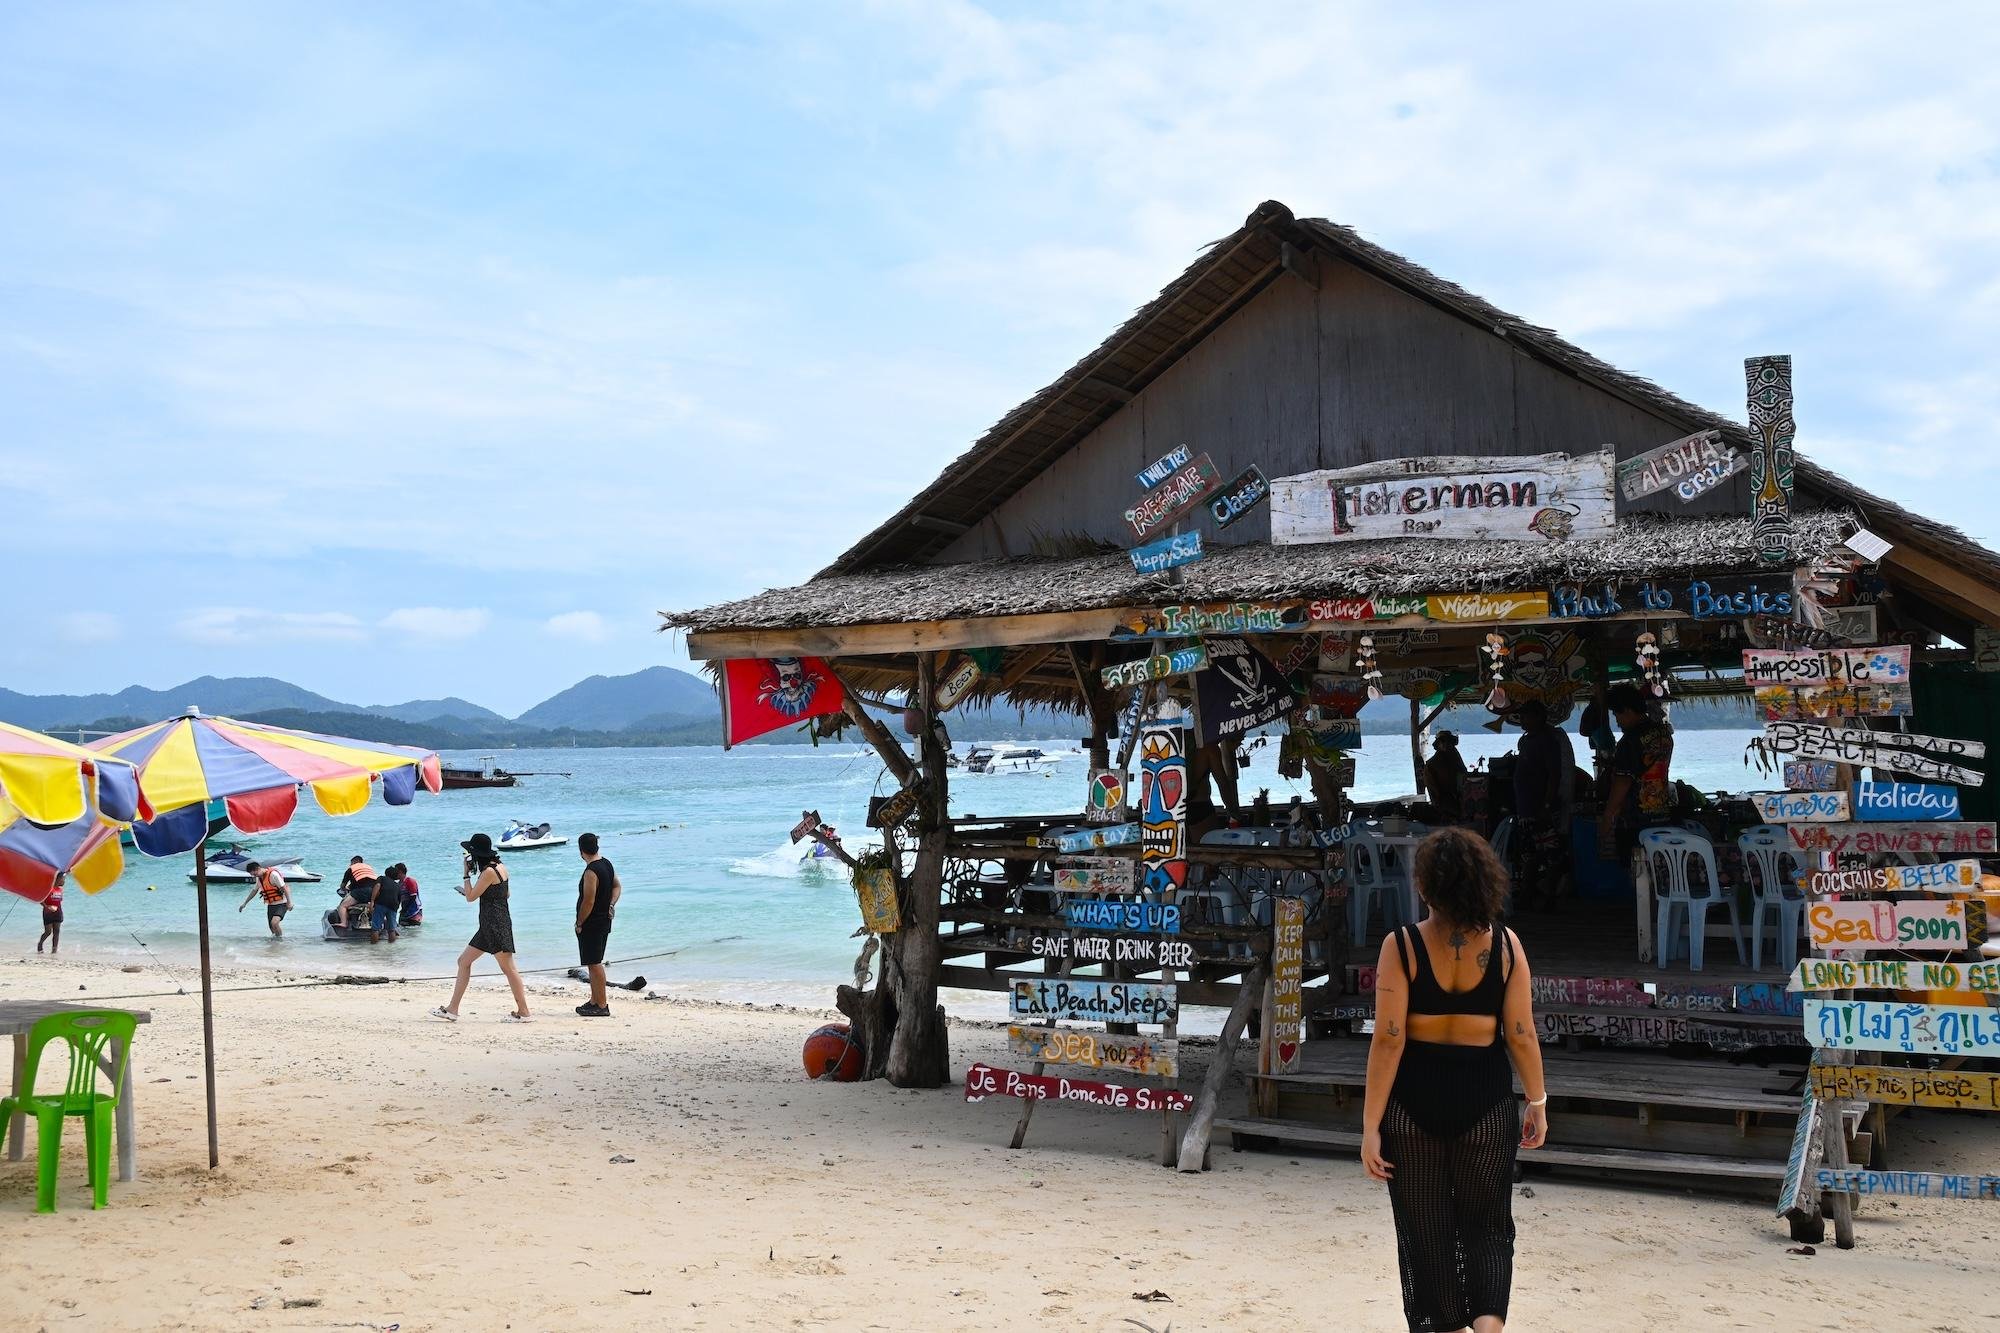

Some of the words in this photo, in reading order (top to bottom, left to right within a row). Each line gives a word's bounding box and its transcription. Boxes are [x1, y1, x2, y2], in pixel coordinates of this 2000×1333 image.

[1169, 449, 1188, 469] TRY
[1400, 459, 1438, 473] The
[1641, 439, 1719, 491] ALOHA
[1328, 478, 1537, 535] Fisherman
[1402, 518, 1441, 533] Bar
[1639, 582, 1673, 609] to
[1688, 581, 1793, 620] Basics
[948, 669, 973, 697] Beer
[1858, 780, 1957, 819] Holiday
[1088, 810, 1117, 821] PEACE
[1811, 869, 1888, 895] COCKTAILS
[1902, 863, 1958, 888] BEER
[1071, 904, 1141, 928] WHAT'S
[1148, 905, 1180, 930] UP
[1031, 936, 1069, 958] SAVE
[1073, 938, 1112, 961] WATER
[1115, 938, 1156, 962] DRINK
[1158, 941, 1194, 967] BEER
[1276, 946, 1302, 963] CALM
[1281, 966, 1300, 977] AND
[1923, 963, 1961, 991] NO
[1967, 964, 2000, 992] SE
[1276, 1003, 1298, 1018] THE
[1006, 1072, 1047, 1100] Pens
[1941, 1175, 1970, 1199] ME
